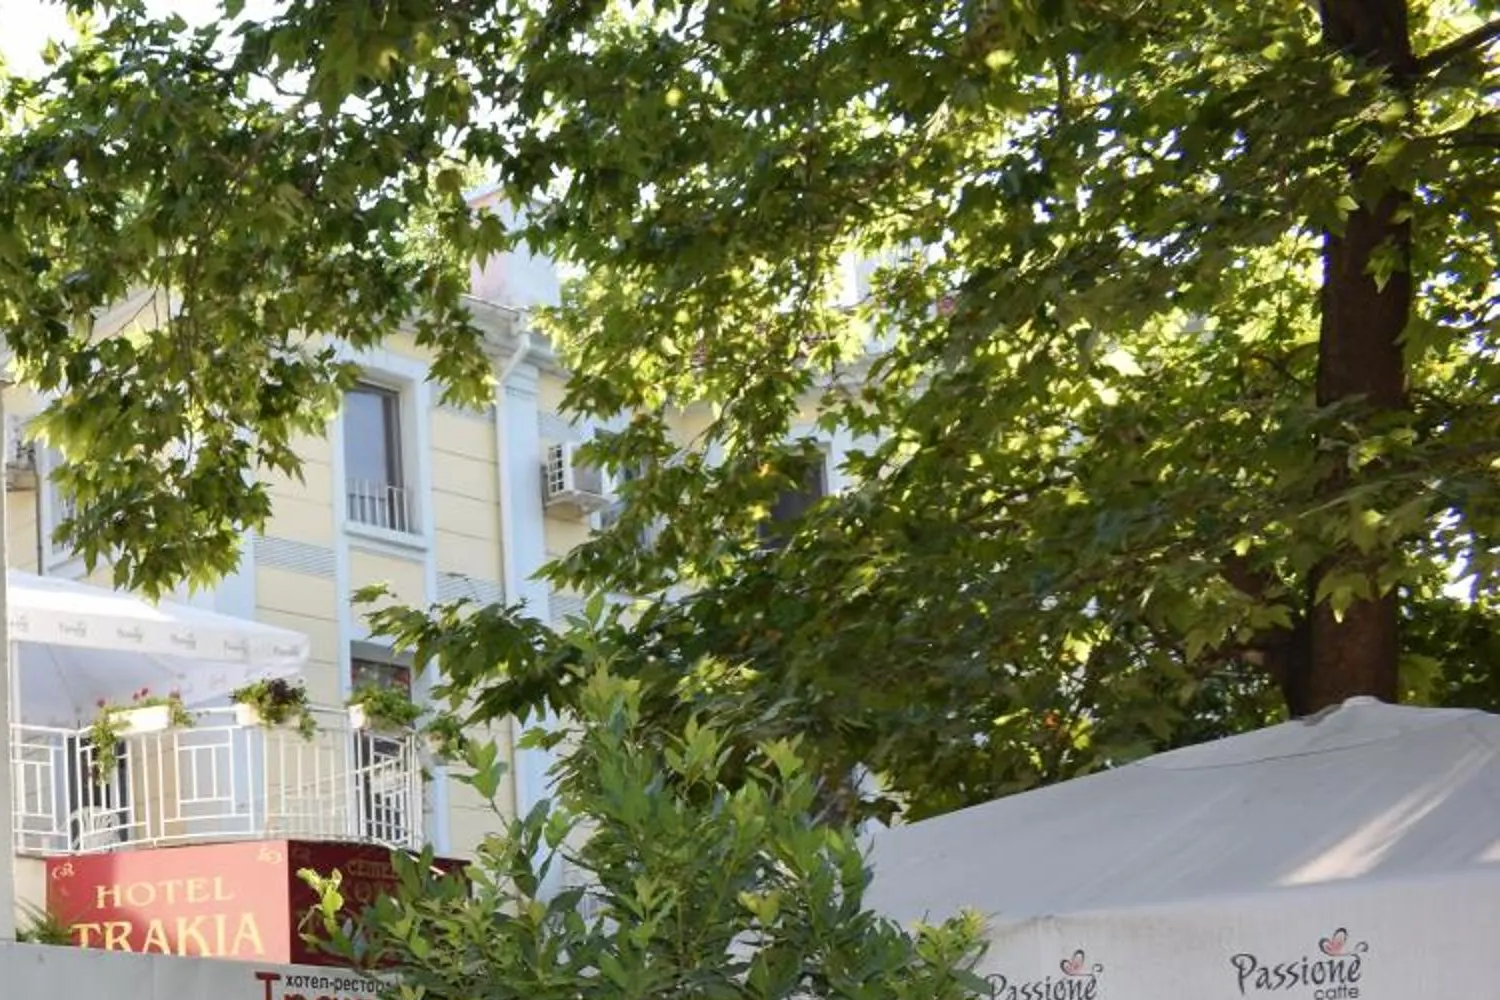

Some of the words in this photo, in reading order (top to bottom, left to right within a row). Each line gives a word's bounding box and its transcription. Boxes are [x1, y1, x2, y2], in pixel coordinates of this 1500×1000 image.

[95, 875, 236, 909] HOTEL
[68, 911, 265, 957] TRAKIA
[285, 974, 391, 997] хотел-рестор
[1230, 952, 1362, 996] Passione
[1313, 984, 1360, 1000] caffe
